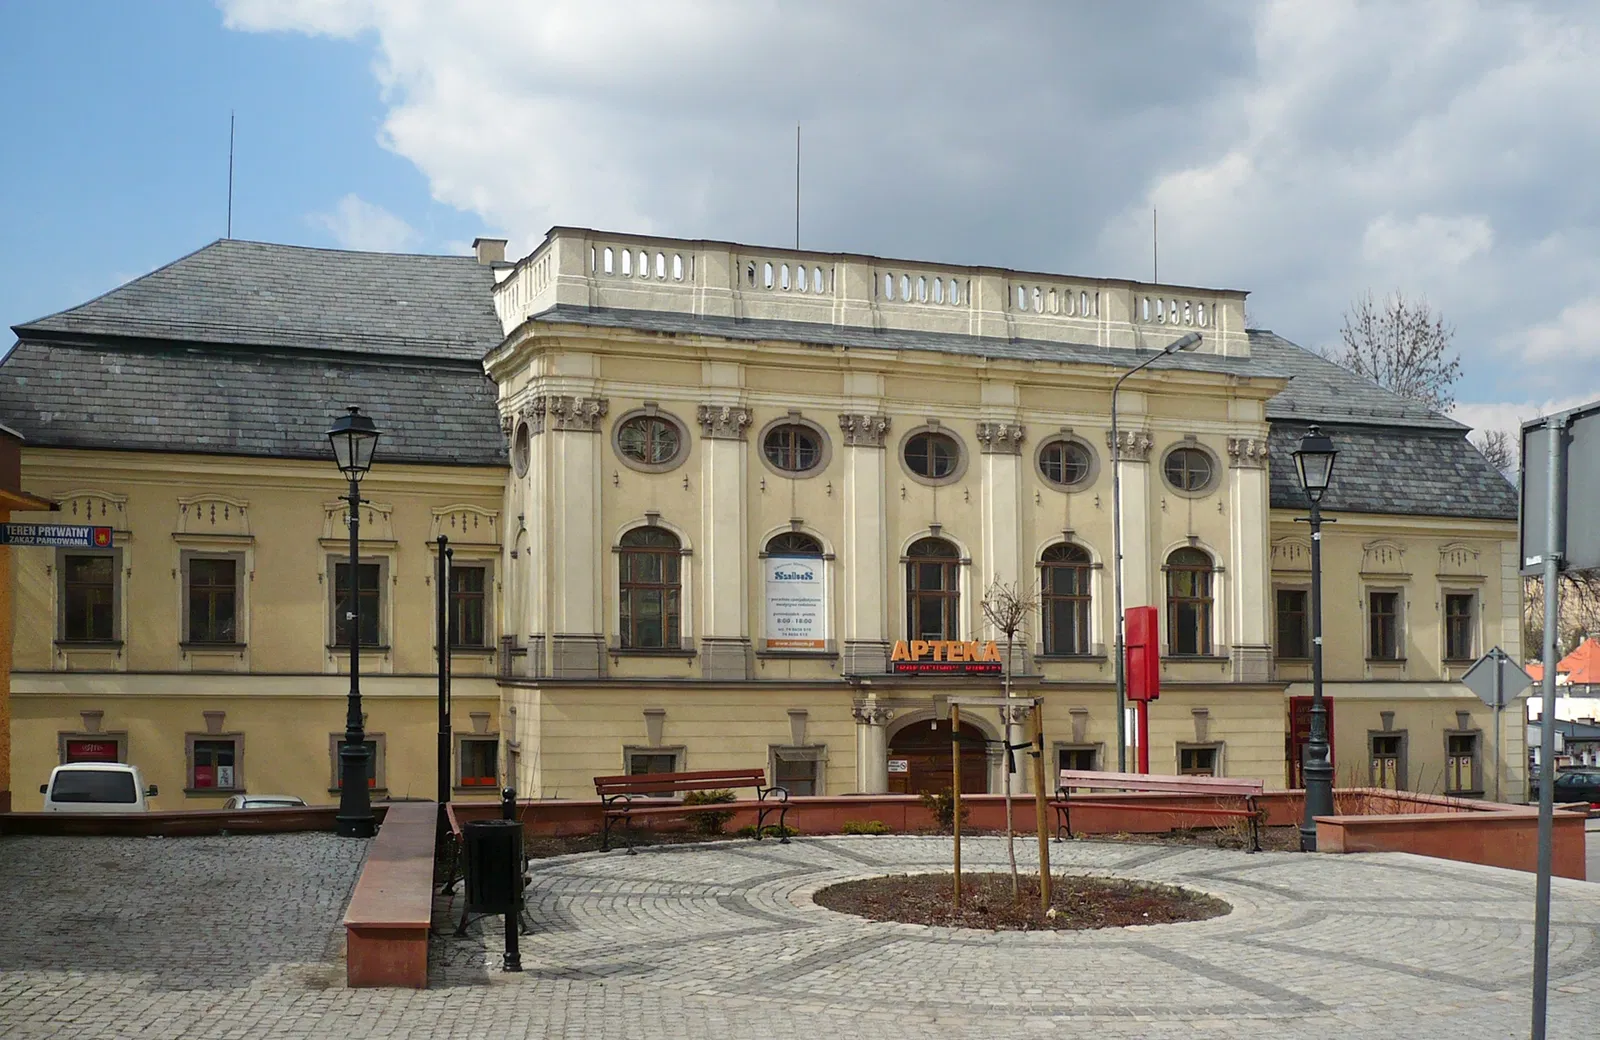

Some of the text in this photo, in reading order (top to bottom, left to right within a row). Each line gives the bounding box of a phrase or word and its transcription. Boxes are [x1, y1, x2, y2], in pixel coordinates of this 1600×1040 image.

[6, 525, 89, 538] TEREN PRYWATNY
[9, 536, 88, 545] ZAKAZ PARKOWANIA
[891, 640, 1001, 662] APTEKA
